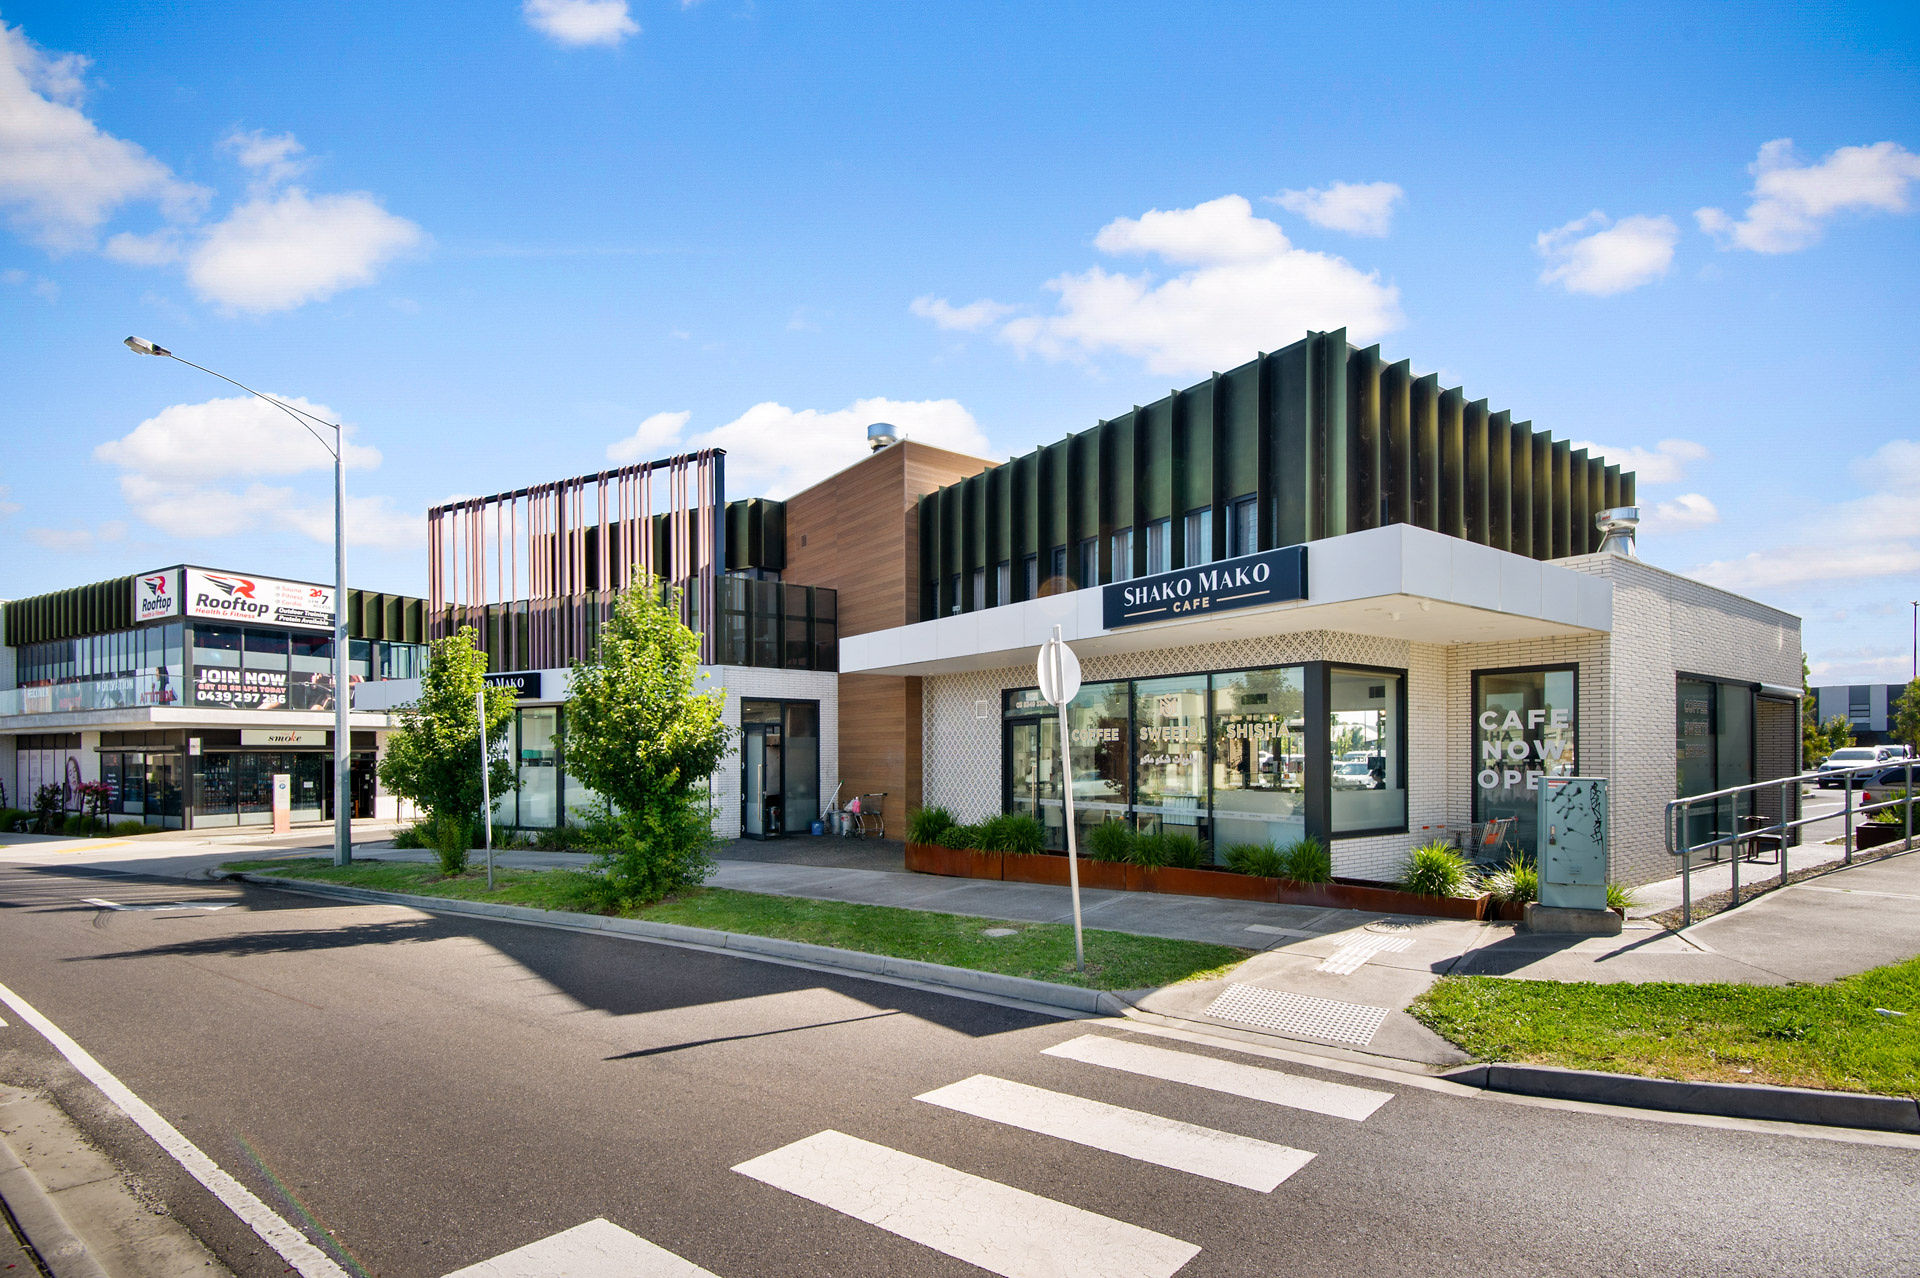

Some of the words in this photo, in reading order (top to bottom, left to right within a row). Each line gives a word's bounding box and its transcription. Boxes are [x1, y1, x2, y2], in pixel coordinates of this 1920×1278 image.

[1124, 577, 1192, 607] SHAKO
[1198, 562, 1271, 594] MAKO
[142, 595, 172, 612] Rooftop
[195, 593, 270, 617] Rooftop
[1172, 596, 1211, 614] CAFE
[195, 607, 222, 616] Health
[229, 609, 256, 619] Fitness
[199, 668, 241, 684] JOIN
[244, 671, 287, 686] NOW
[496, 677, 525, 689] MAKO
[197, 690, 232, 702] 0439
[234, 692, 260, 703] 297
[259, 686, 287, 694] TODAY
[1478, 708, 1570, 731] CAFE
[267, 731, 302, 742] smoke
[1071, 728, 1120, 742] COFFEE
[1139, 726, 1198, 741] SWEETS
[1226, 722, 1291, 739] SHISHA
[1482, 739, 1567, 761] NOW
[1477, 769, 1539, 790] OPE
